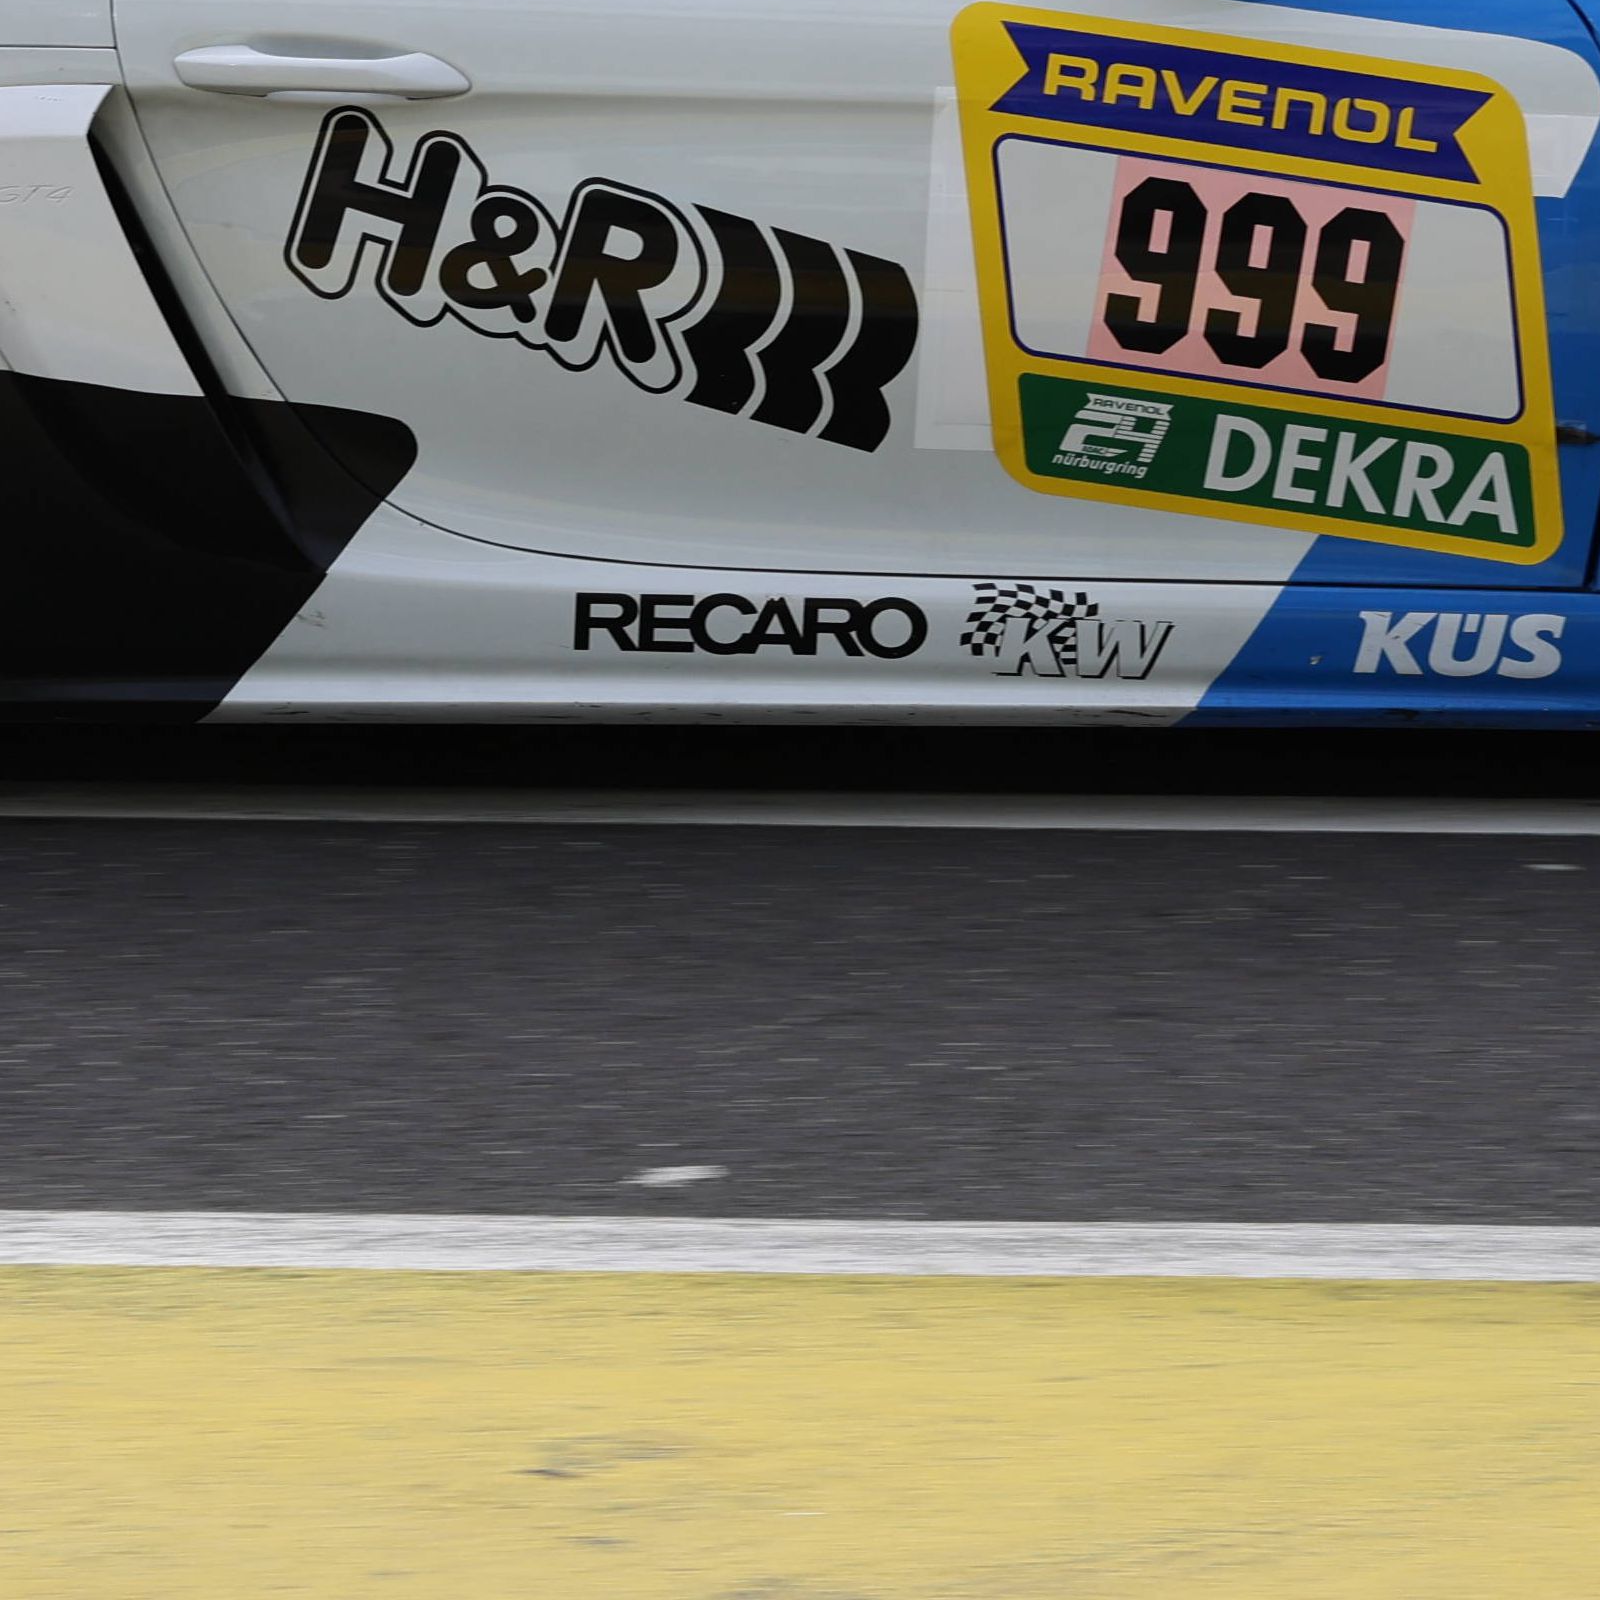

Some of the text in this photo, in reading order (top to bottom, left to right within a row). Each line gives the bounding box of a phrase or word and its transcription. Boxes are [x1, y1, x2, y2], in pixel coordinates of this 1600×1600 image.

[1043, 52, 1439, 154] RAVENOL
[284, 104, 708, 395] H&R
[1103, 176, 1406, 384] 999
[1092, 397, 1167, 417] RAVENOL
[1051, 452, 1149, 479] nürburgring
[1203, 413, 1519, 535] DEKRA
[573, 591, 929, 659] RECARO
[992, 617, 1176, 680] KW
[1352, 610, 1567, 680] KÜS
